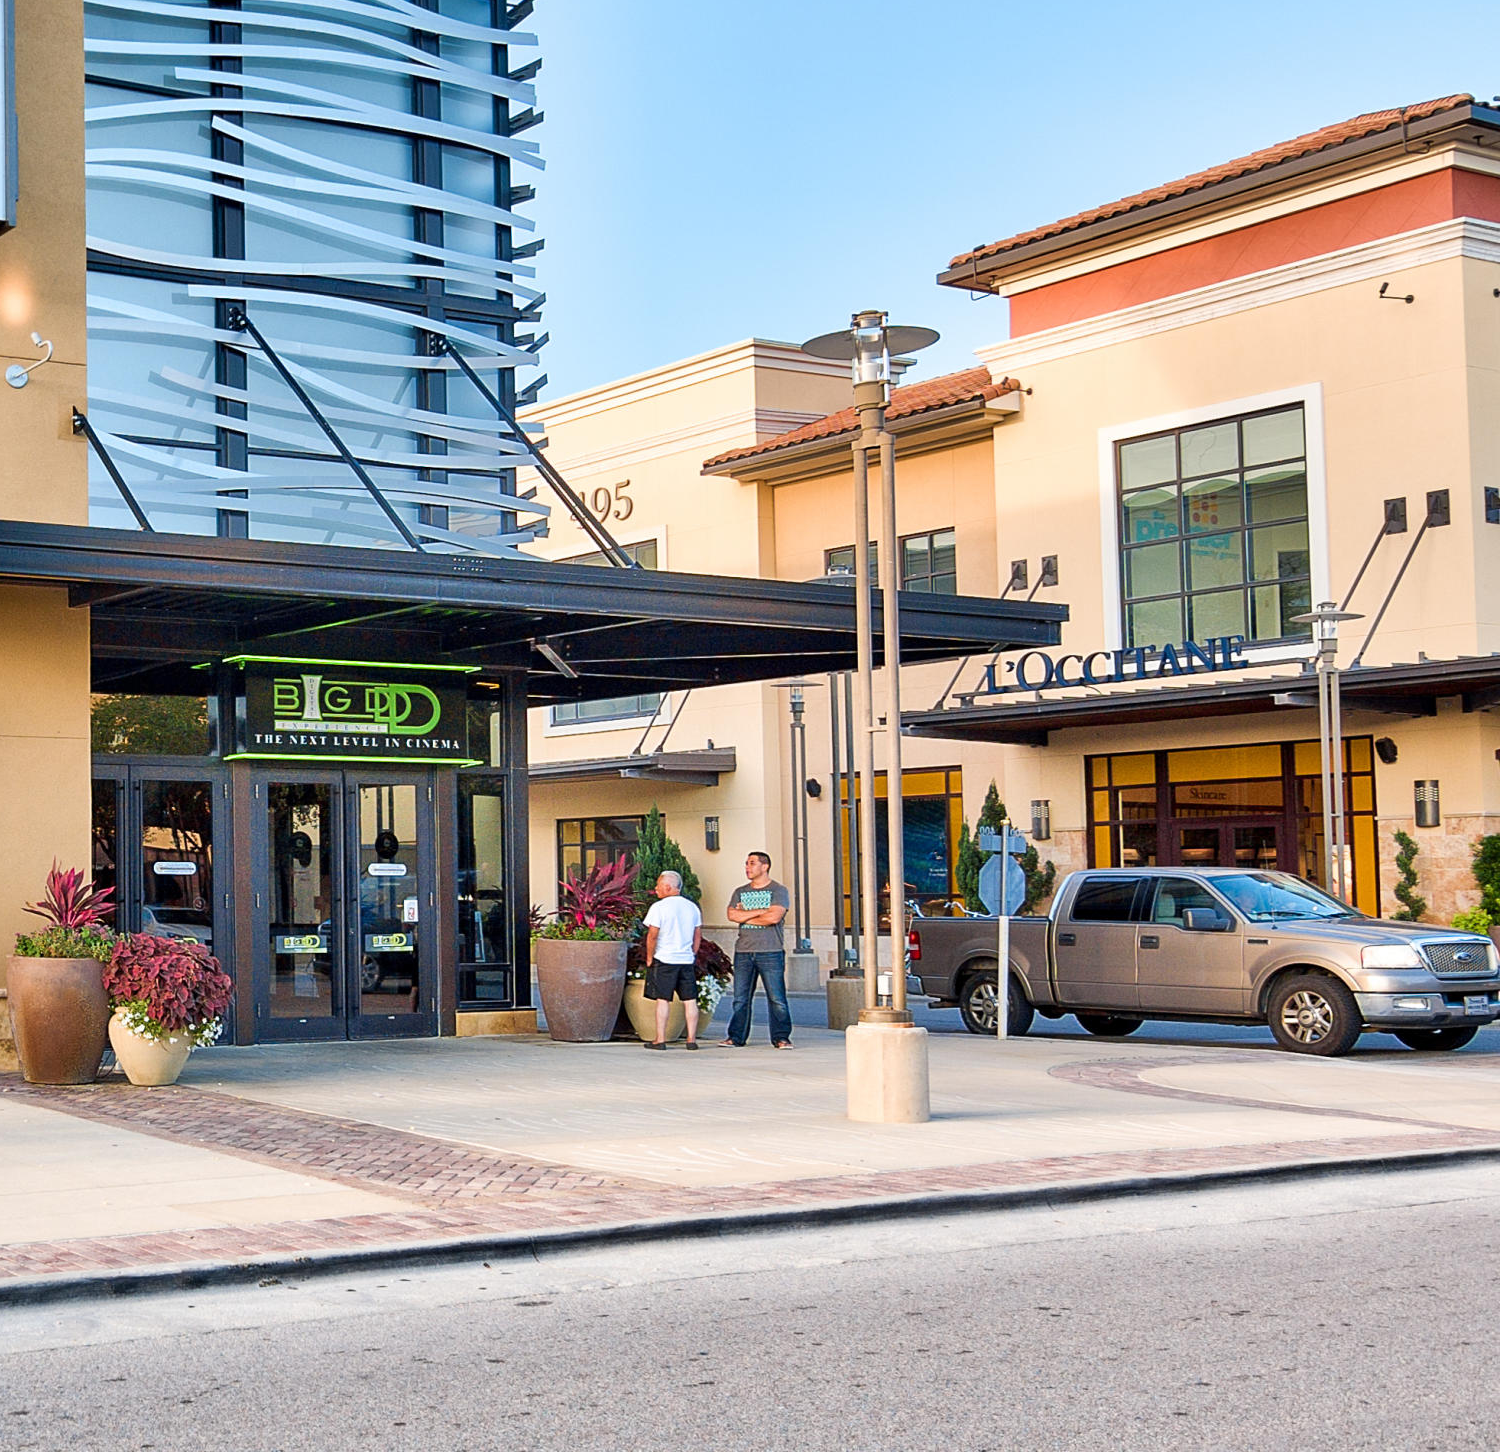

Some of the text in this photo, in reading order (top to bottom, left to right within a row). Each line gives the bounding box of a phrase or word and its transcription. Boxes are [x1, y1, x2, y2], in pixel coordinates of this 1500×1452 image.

[983, 635, 1249, 694] L'OCCITANE
[254, 733, 460, 749] THE NEXT LEVEL IN CINEMA
